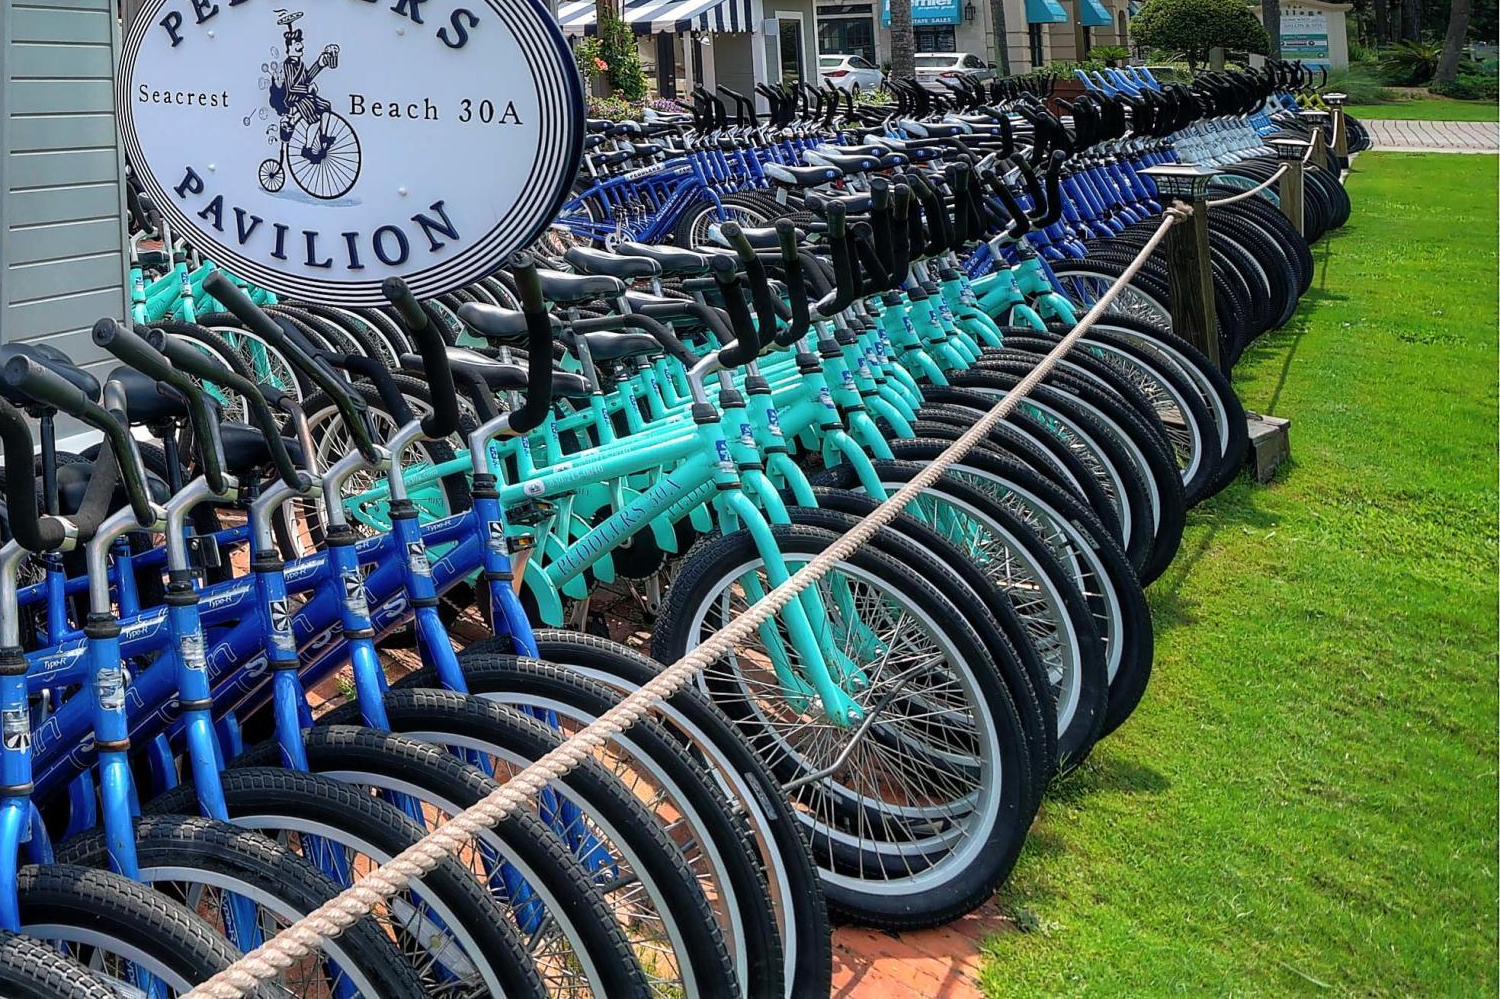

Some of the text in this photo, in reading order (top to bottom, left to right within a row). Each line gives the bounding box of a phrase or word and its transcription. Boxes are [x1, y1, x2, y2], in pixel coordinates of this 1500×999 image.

[138, 83, 524, 126] Seacrest Beach 30A
[173, 166, 461, 270] PAVILION
[557, 504, 646, 576] PEDDLERS
[125, 625, 149, 639] Type-R
[43, 656, 67, 669] Type-R
